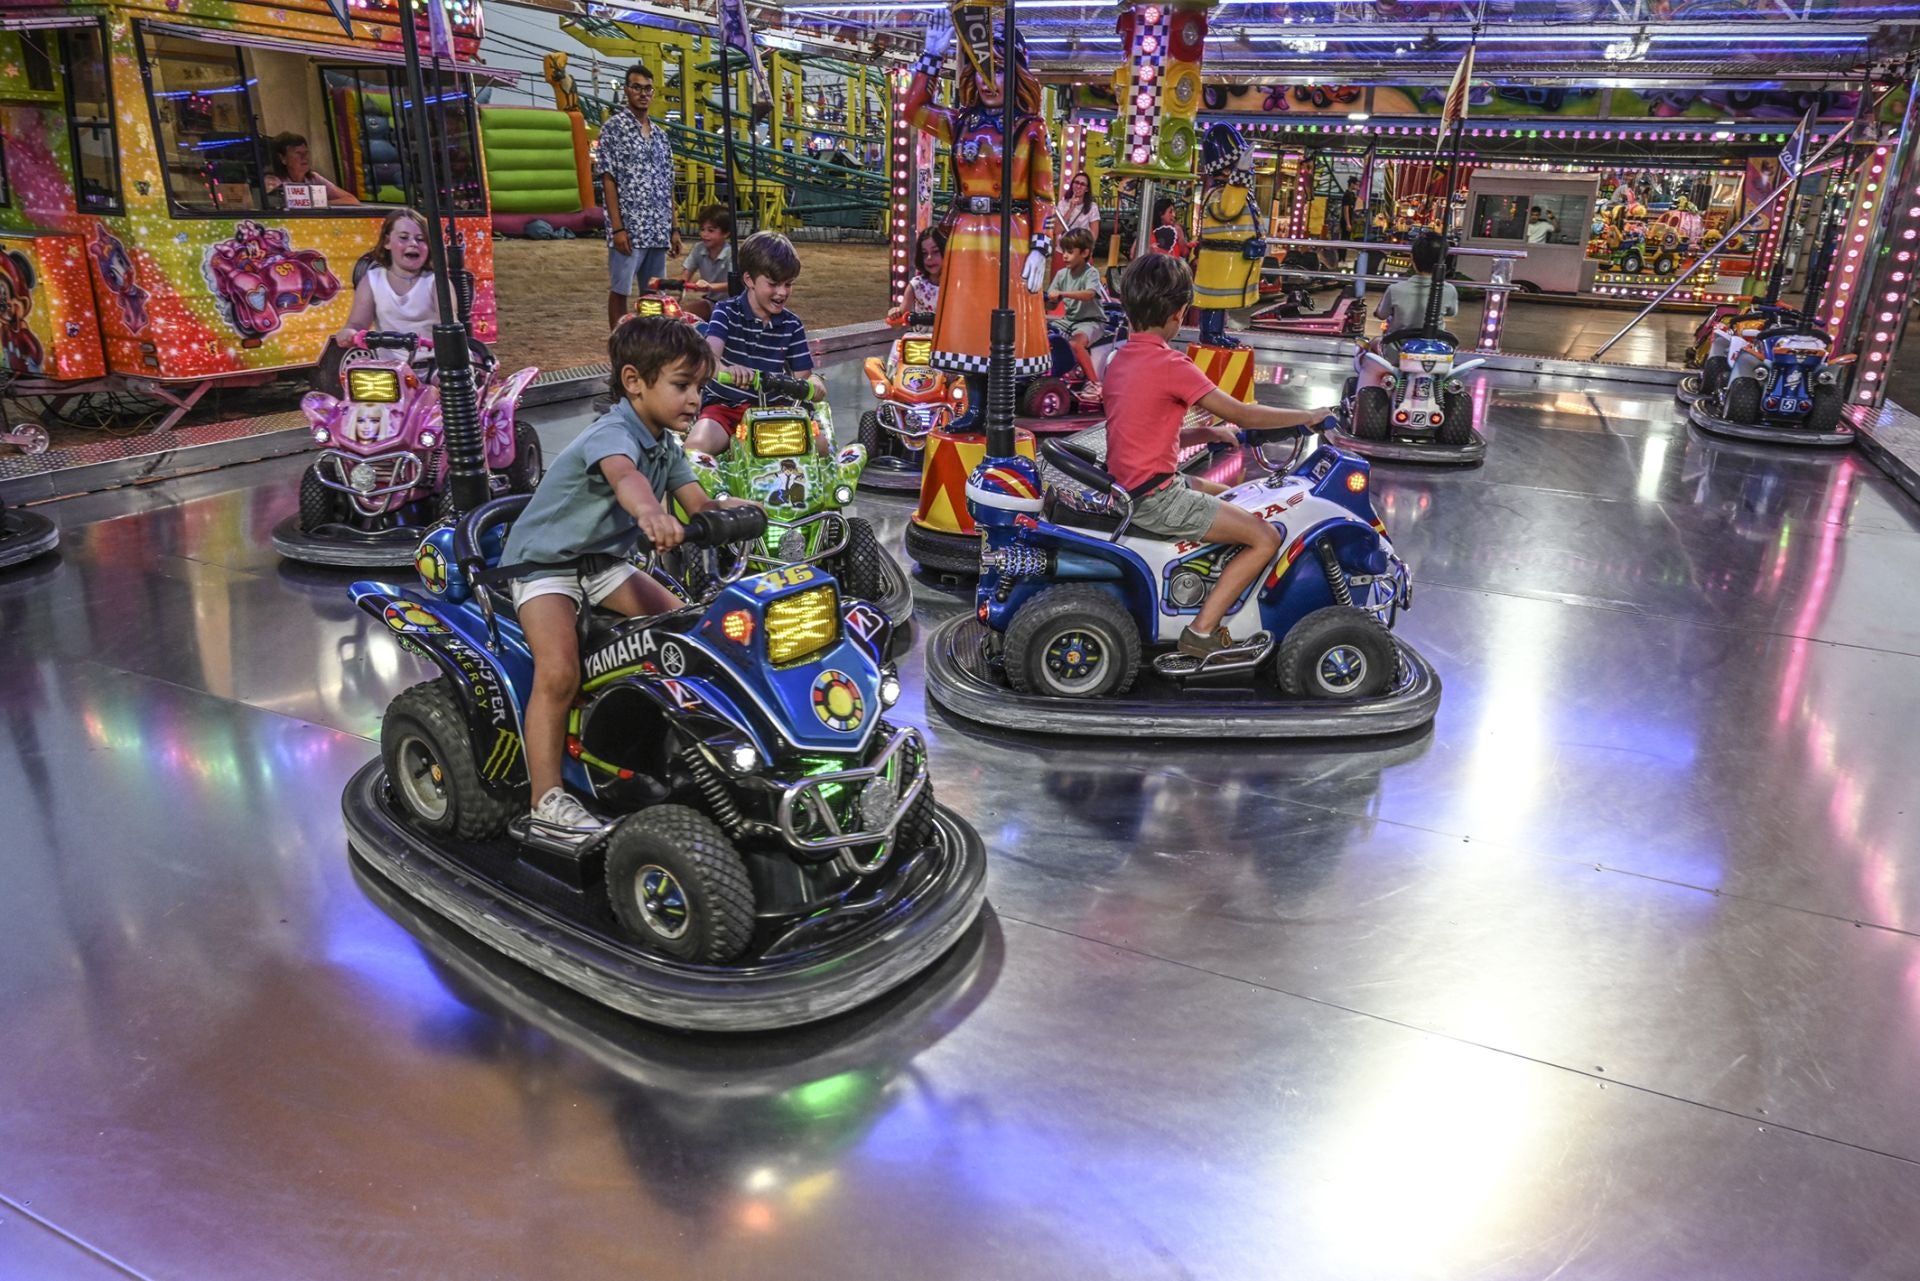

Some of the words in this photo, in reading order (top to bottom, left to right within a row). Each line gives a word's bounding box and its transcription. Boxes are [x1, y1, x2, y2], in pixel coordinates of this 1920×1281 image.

[275, 262, 295, 276] 89
[1783, 400, 1794, 410] 5
[754, 563, 815, 595] 46
[584, 629, 659, 679] YAMAHA
[448, 638, 507, 725] MONSTER
